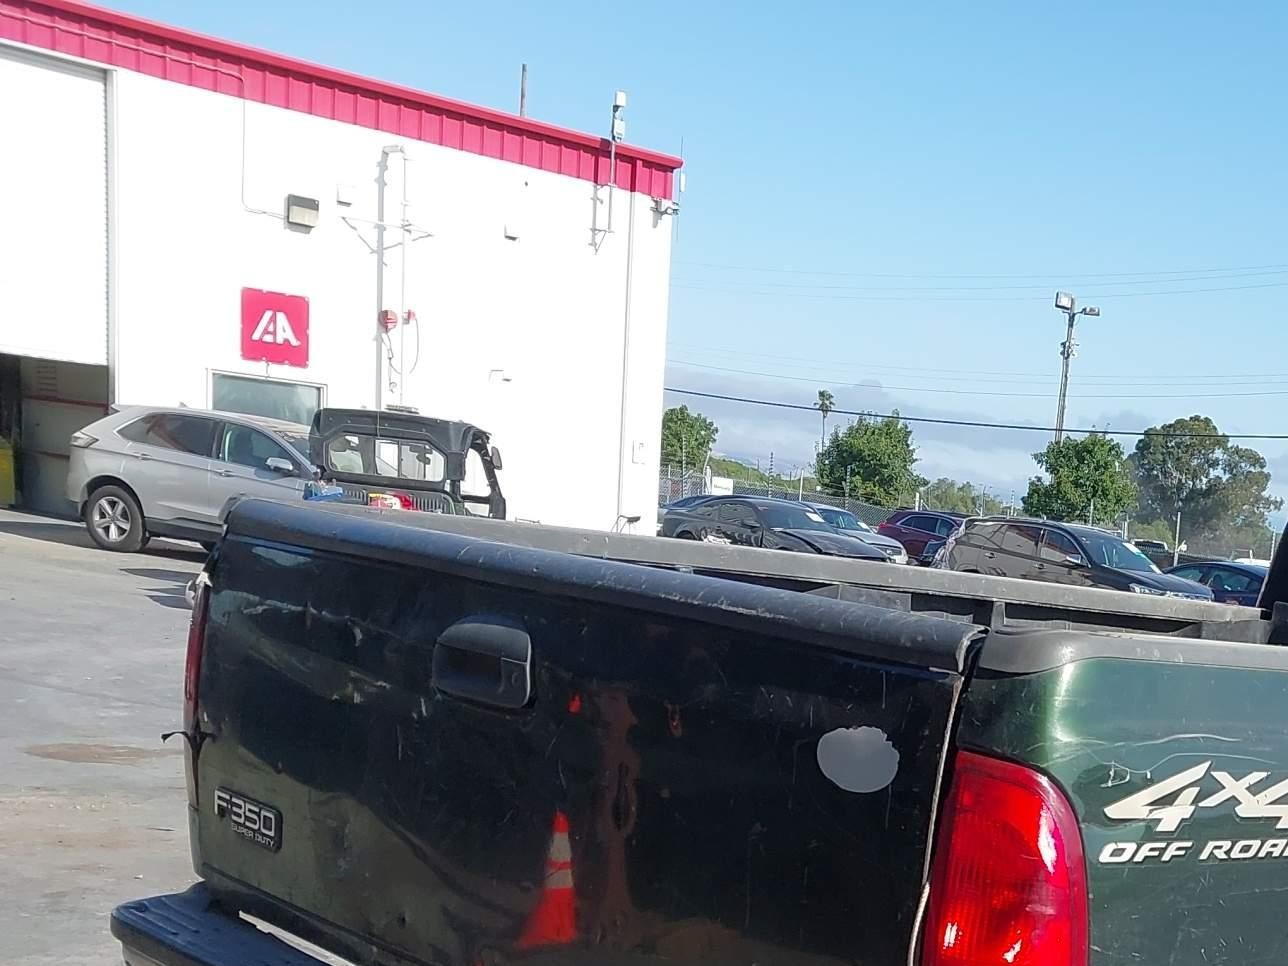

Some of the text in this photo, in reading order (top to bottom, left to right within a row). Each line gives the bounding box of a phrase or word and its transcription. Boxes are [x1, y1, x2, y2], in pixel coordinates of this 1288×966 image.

[231, 822, 275, 848] SUPER DUTY
[1098, 841, 1193, 863] OFF
